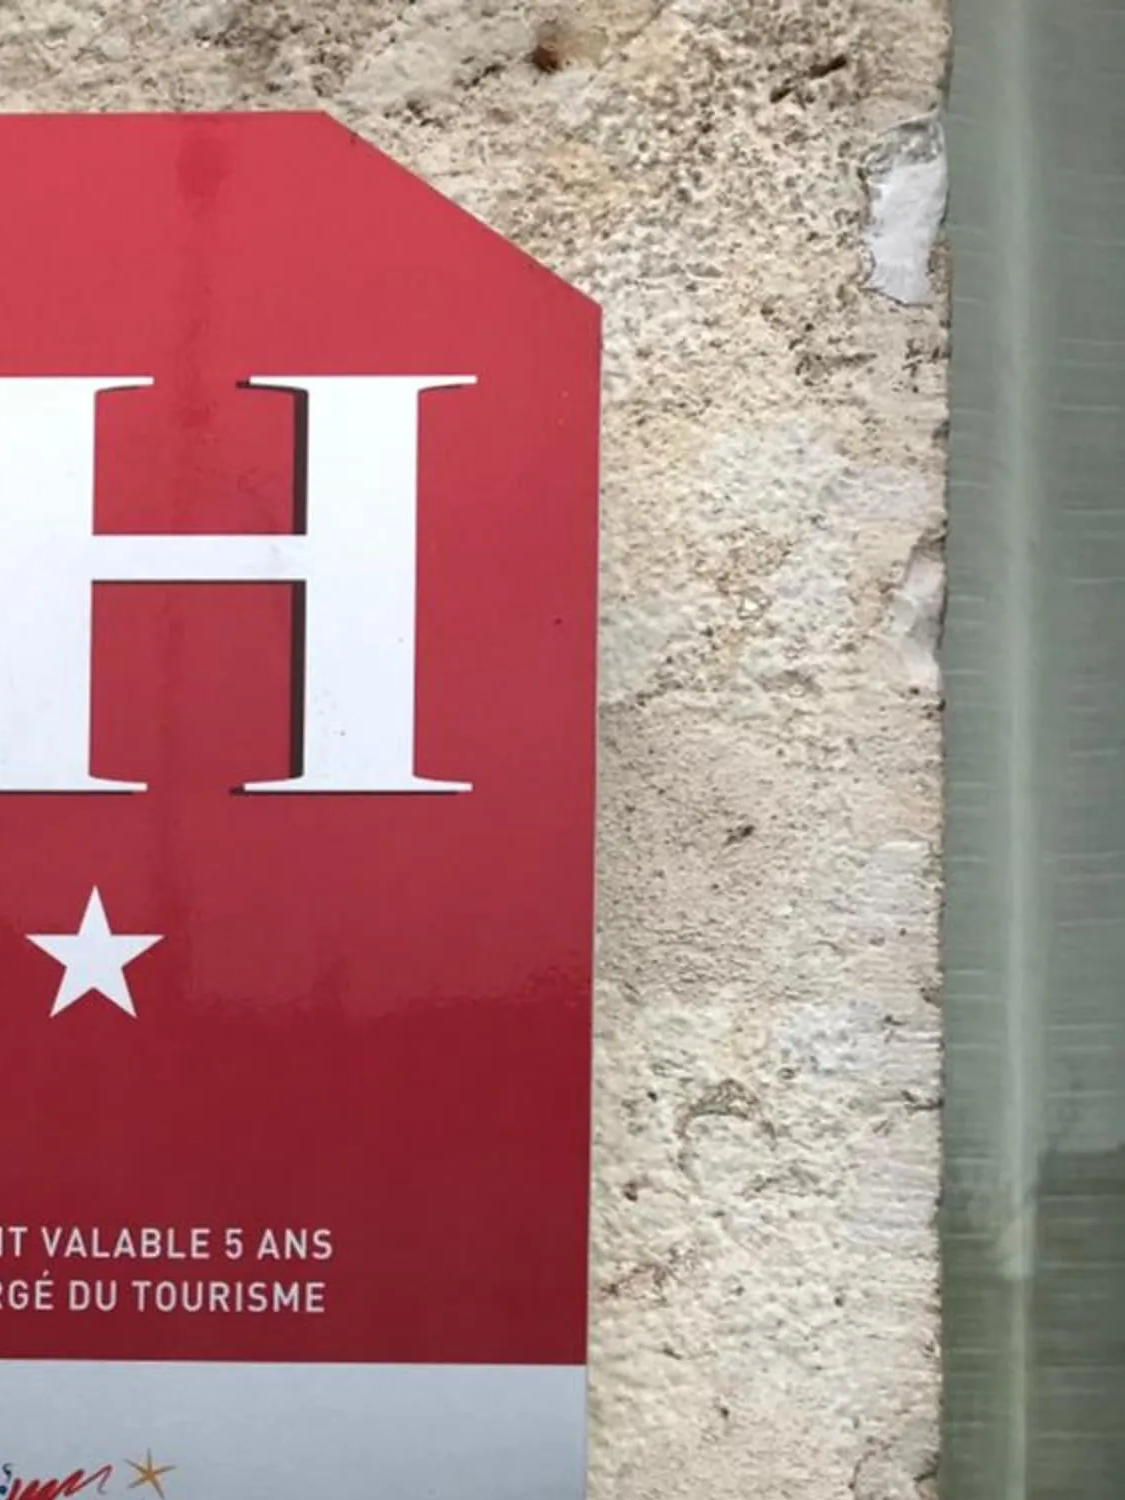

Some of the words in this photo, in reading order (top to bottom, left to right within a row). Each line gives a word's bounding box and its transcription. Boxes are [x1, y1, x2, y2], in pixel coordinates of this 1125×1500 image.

[41, 1227, 210, 1259] VALABLE
[224, 1228, 244, 1259] 5
[257, 1229, 334, 1260] ANS
[69, 1280, 118, 1312] DU
[135, 1280, 326, 1313] TOURISME
